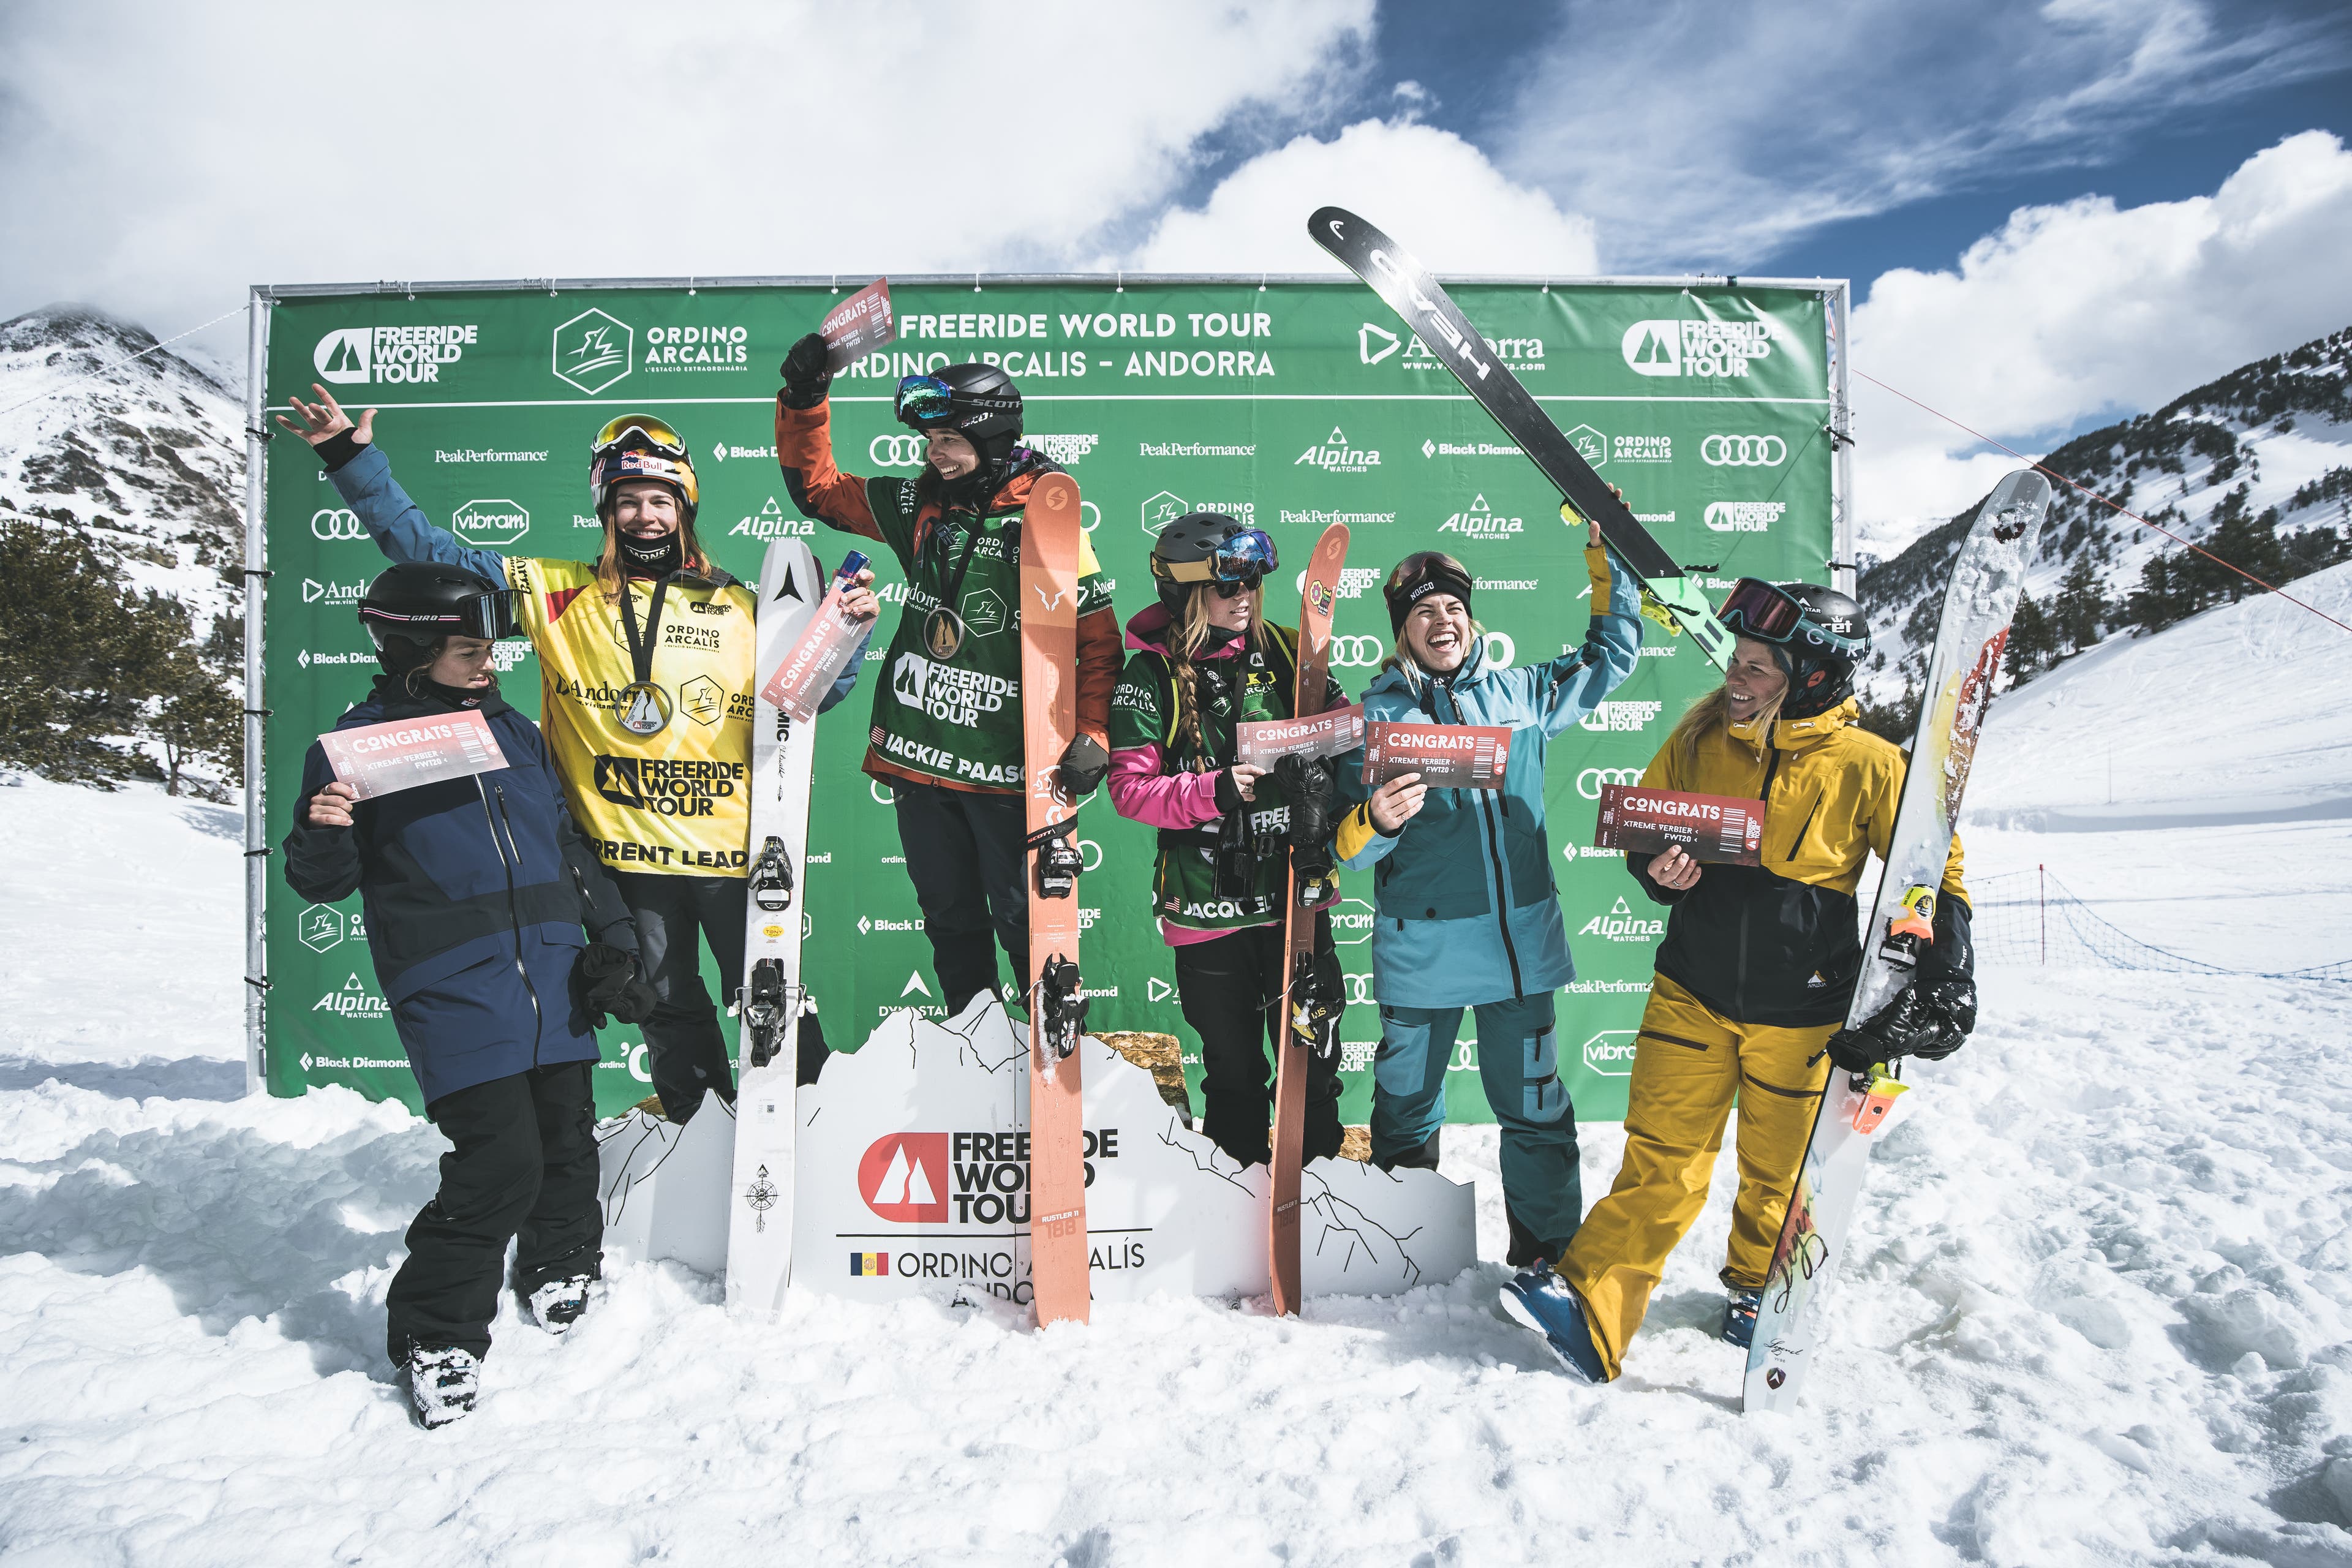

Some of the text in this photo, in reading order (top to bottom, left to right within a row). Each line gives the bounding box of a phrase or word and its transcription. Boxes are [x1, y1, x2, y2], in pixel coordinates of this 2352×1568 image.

[821, 299, 867, 337] CONGRATS
[900, 312, 1272, 338] FREERIDE WORLD TOUR
[374, 325, 478, 345] FREERIDE
[647, 326, 747, 344] ORDINO
[1681, 320, 1782, 340] FREERIDE
[827, 337, 840, 351] TREME
[846, 338, 861, 349] FWT20
[1684, 338, 1770, 358] WORLD
[374, 344, 461, 364] WORLD
[645, 341, 747, 364] ARCALÍS
[1125, 351, 1275, 376] ANDORRA
[1683, 356, 1749, 377] TOUR
[372, 363, 439, 383] TOUR
[971, 399, 1021, 409] SCOTT
[1044, 434, 1098, 445] FREERIDE
[1614, 435, 1672, 447] ORDINO
[435, 448, 548, 462] PeakPerformance
[731, 447, 769, 458] Black
[1045, 444, 1091, 454] WORLD
[1139, 442, 1255, 456] PeakPerformance
[1439, 443, 1525, 454] Black Diamo
[1613, 445, 1672, 459] ARCALÍS
[1294, 446, 1381, 469] Alpina
[622, 461, 662, 470] Red Bull
[1196, 502, 1254, 513] ORDINO
[1735, 502, 1785, 513] FREERIDE
[457, 508, 526, 529] vibram
[1280, 510, 1396, 523] PeakPerformance
[1735, 511, 1779, 522] WORLD
[728, 516, 815, 540] Alpina
[1437, 513, 1525, 537] Alpina
[1735, 521, 1768, 532] TOUR
[1338, 578, 1373, 589] ORLD
[1706, 578, 1739, 589] Blac
[1335, 587, 1362, 598] OUR
[1411, 582, 1434, 601] NOCCO
[666, 625, 720, 638] ORDINO
[665, 635, 720, 648] ARCALÍS
[313, 653, 348, 664] Black
[492, 651, 525, 662] ORLD
[780, 619, 831, 690] CONGRATS
[822, 652, 838, 672] FWT20
[797, 647, 834, 697] XTREME VERBIER
[928, 662, 1019, 698] FREERIDE
[928, 679, 1002, 713] WORLD
[924, 696, 979, 728] TOUR
[1608, 701, 1662, 711] FREERIDE
[1609, 710, 1654, 721] WORLD
[1256, 719, 1332, 741] CONGRATS
[1609, 720, 1643, 731] TOUR
[352, 725, 453, 754] CONGRATS
[1287, 741, 1314, 750] VERBIER
[1388, 733, 1475, 750] CONGRATS
[886, 733, 953, 771] JACKIE
[367, 750, 439, 771] XTREME VERBIER
[414, 760, 442, 769] FWT20
[640, 758, 744, 780] FREERIDE
[641, 778, 734, 797] WORLD
[644, 796, 714, 816] TOUR
[1623, 796, 1721, 820] CONGRATS
[1250, 805, 1290, 829] FREE
[1624, 820, 1692, 834] XTREME VERBIER
[1027, 830, 1052, 843] SCOTT
[1664, 834, 1691, 843] FWT20
[593, 838, 748, 869] RRENT LEAD
[1580, 846, 1618, 858] Black
[875, 920, 912, 930] Black
[1578, 916, 1664, 939] Alpina
[1080, 986, 1118, 997] mond
[316, 1057, 350, 1068] Black
[1342, 1052, 1375, 1062] ORLD
[1338, 1061, 1365, 1072] OUR
[954, 1129, 1118, 1161] FREEDE
[954, 1194, 1030, 1224] TOU
[1277, 1201, 1294, 1212] RUSTLER
[1042, 1210, 1072, 1223] RUSTLER
[1045, 1220, 1076, 1239] 188
[898, 1252, 1012, 1278] ORDINO
[1763, 1338, 1804, 1356] Legend
